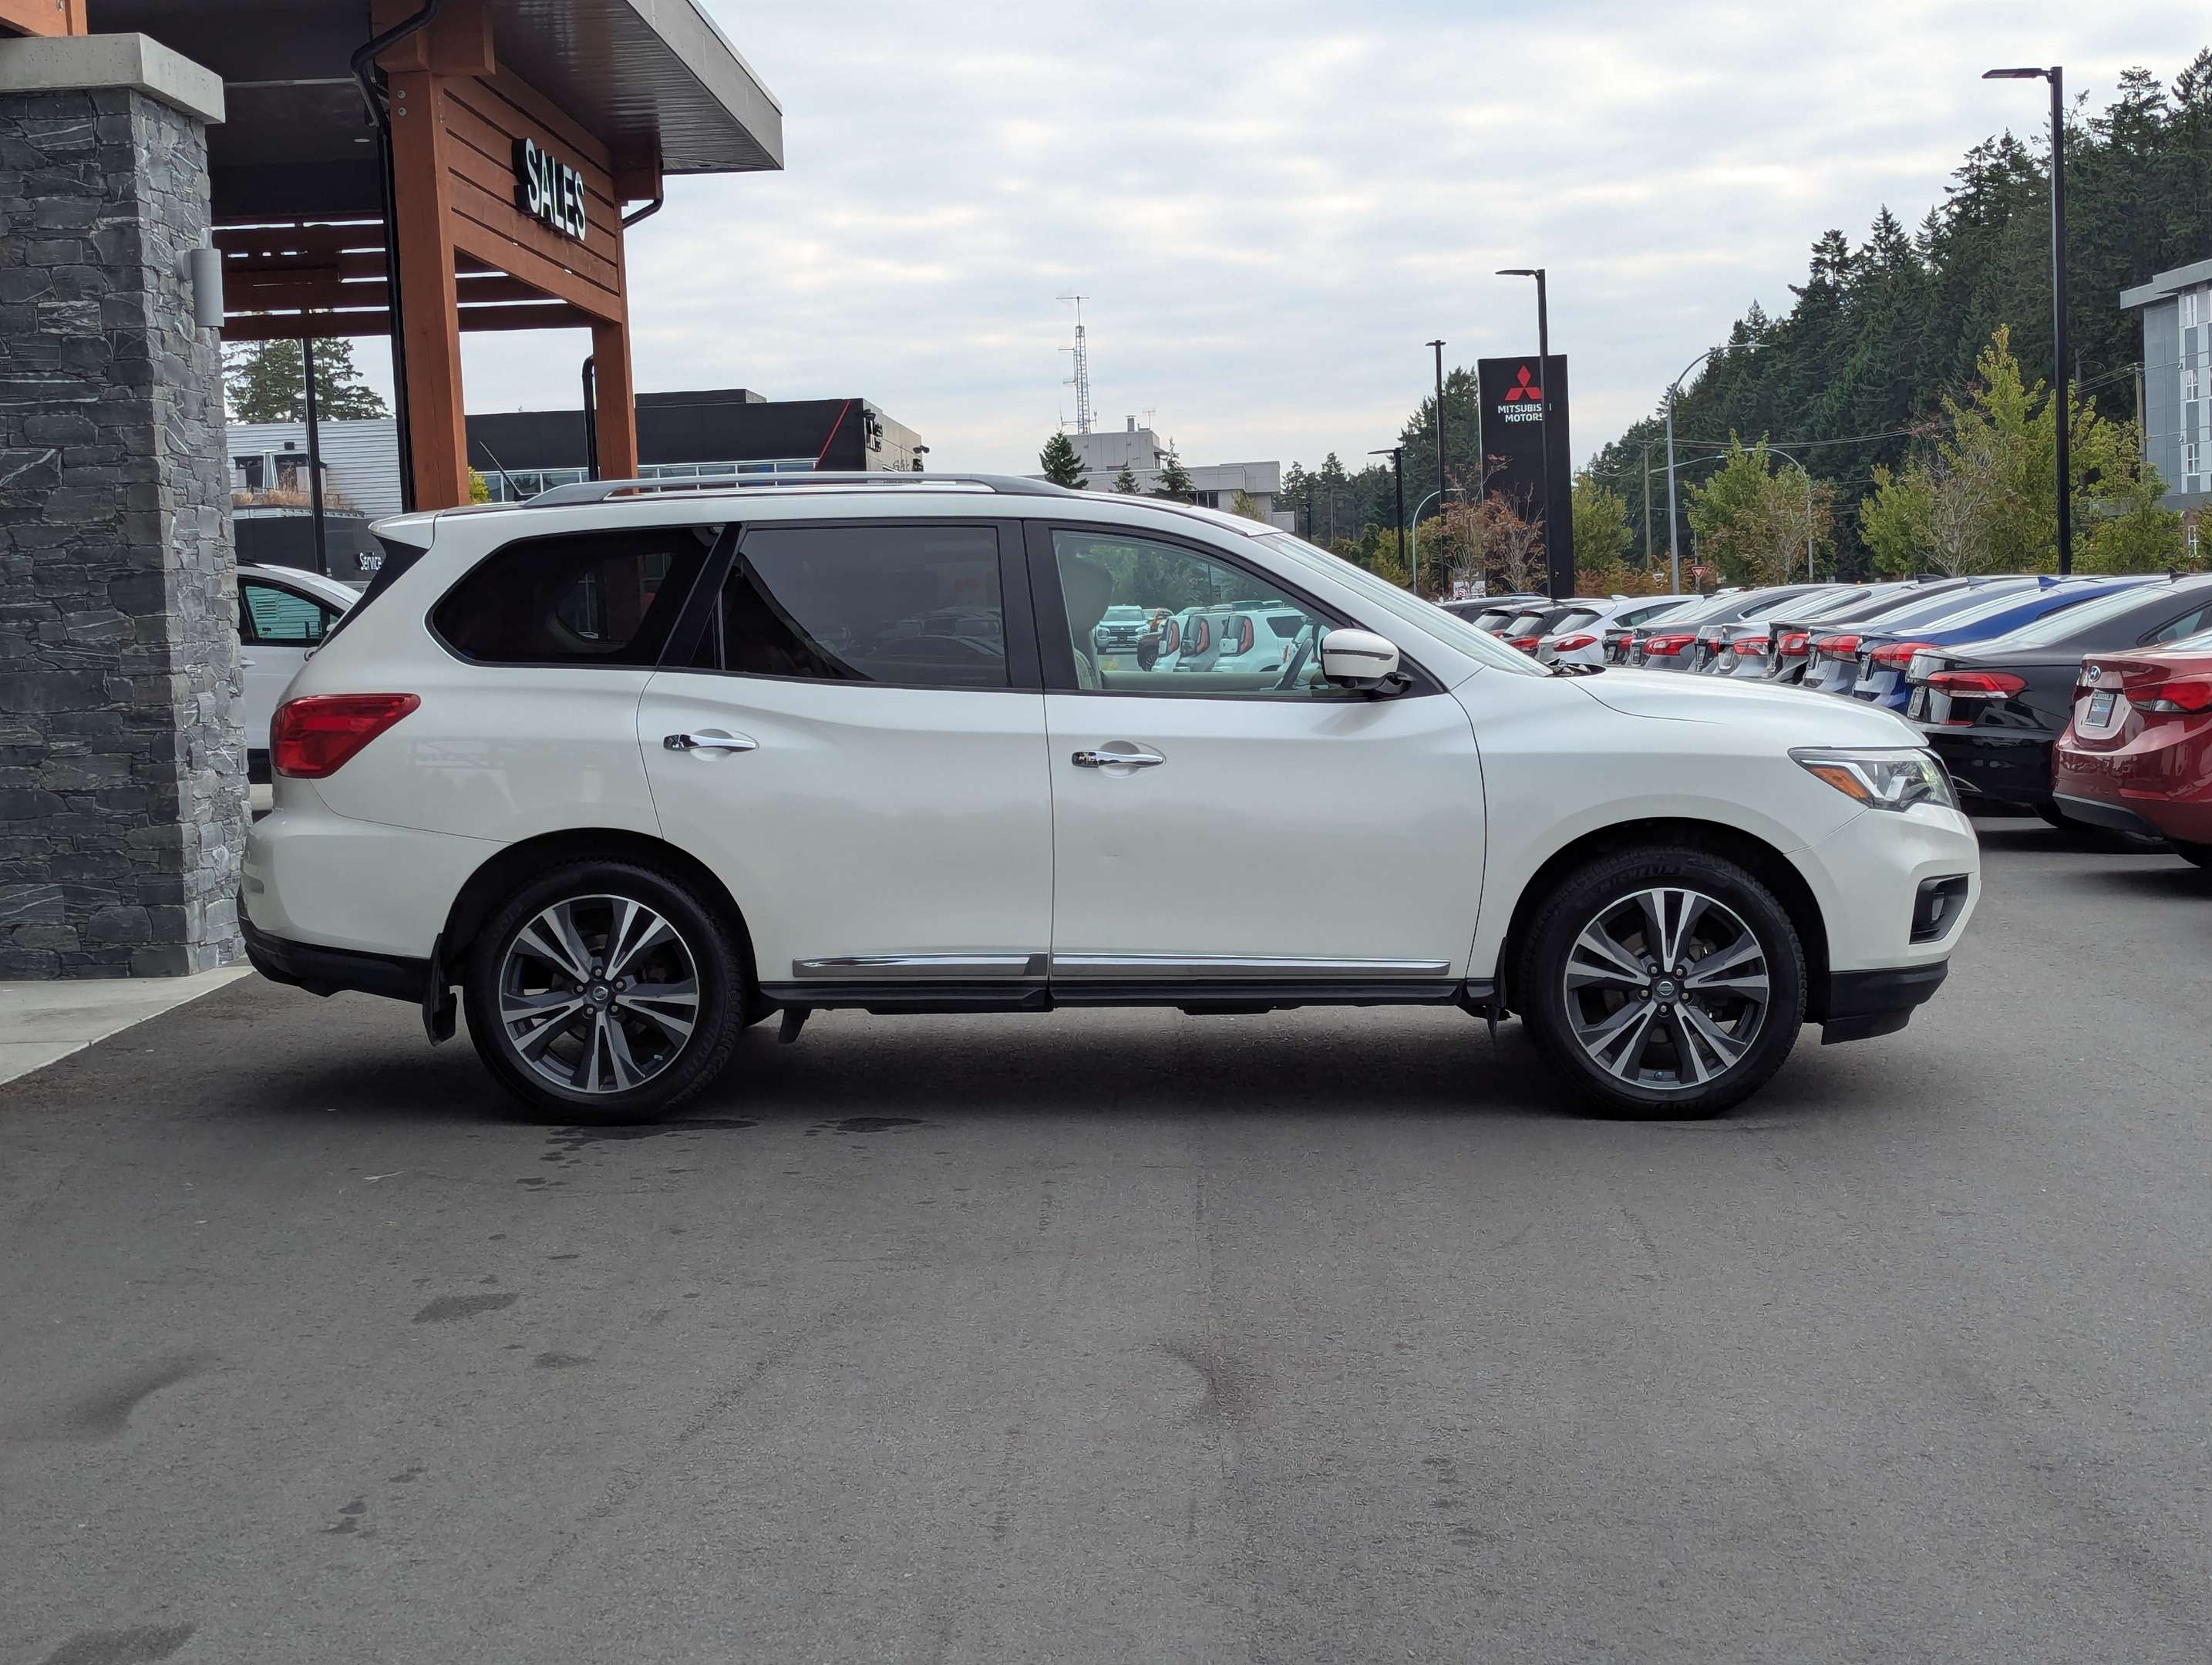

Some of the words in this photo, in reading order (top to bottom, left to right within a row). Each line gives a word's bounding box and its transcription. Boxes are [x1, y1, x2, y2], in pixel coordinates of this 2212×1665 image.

[525, 137, 586, 241] SALES
[1497, 402, 1552, 414] MITSUBISI
[359, 551, 382, 570] Service
